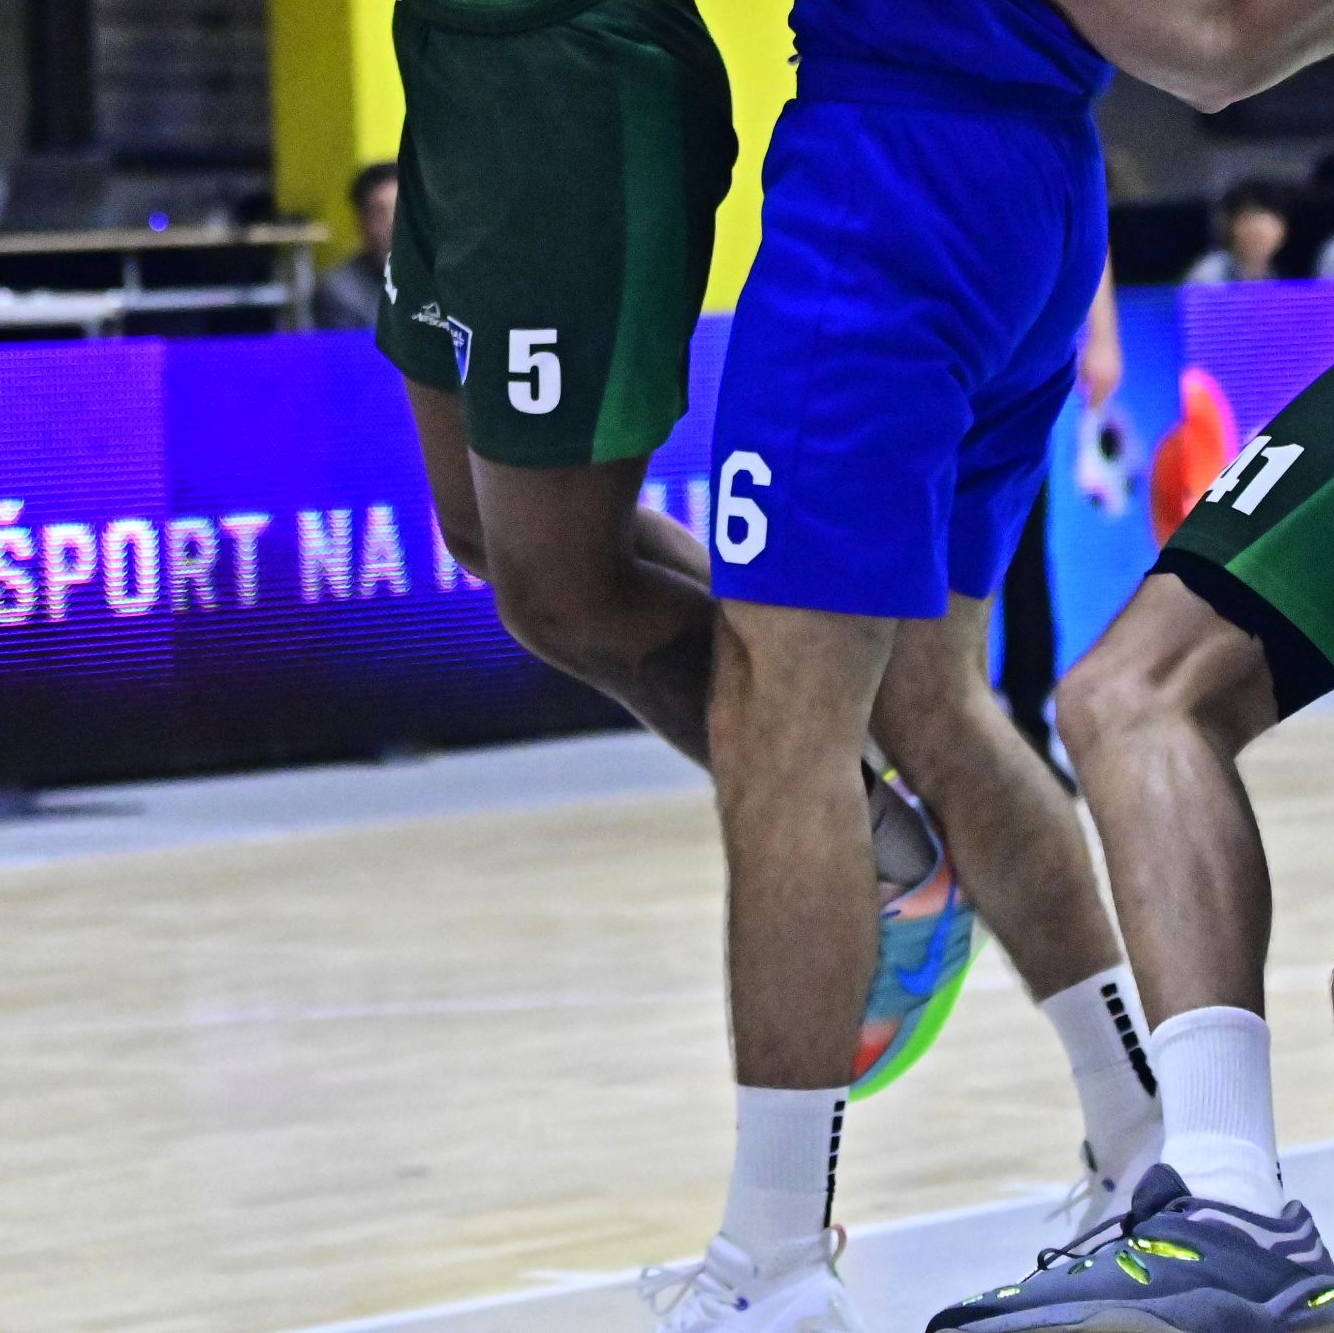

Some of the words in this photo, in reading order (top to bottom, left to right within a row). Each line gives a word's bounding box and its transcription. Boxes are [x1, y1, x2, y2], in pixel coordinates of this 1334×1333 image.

[507, 327, 562, 415] 5
[297, 503, 412, 604] NA
[716, 450, 772, 565] 6
